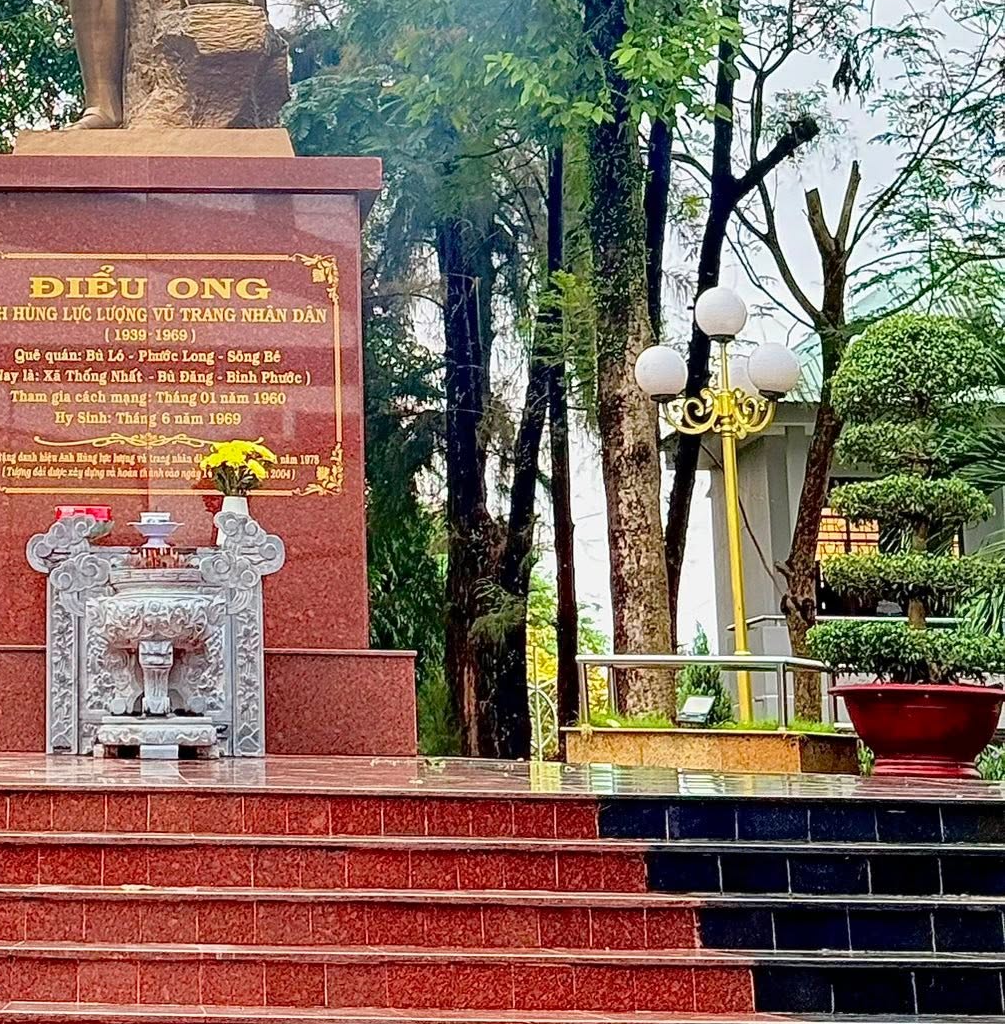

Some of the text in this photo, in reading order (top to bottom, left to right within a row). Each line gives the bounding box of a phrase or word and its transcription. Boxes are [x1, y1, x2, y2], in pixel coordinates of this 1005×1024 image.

[29, 264, 271, 299] ĐIỂU ONG
[12, 303, 58, 321] HÙNG
[62, 305, 92, 324] LỰC
[97, 305, 147, 324] LƯỢNG
[152, 304, 175, 322] VŨ
[180, 307, 236, 322] TRANG
[241, 305, 288, 323] NHÂN
[292, 305, 327, 323] DÂN
[14, 348, 41, 364] Quê
[45, 349, 82, 363] quán:
[86, 349, 104, 362] Bù
[138, 349, 179, 363] Phước
[182, 350, 215, 365] Long
[227, 350, 260, 366] Sông
[263, 350, 281, 363] Bé
[23, 369, 40, 382] là:
[43, 370, 61, 382] Xã
[66, 368, 108, 385] Thống
[111, 367, 143, 383] Nhất
[157, 370, 175, 383] Bù
[180, 371, 214, 386] Đăng
[226, 370, 257, 384] Bình
[261, 371, 302, 384] Phước
[10, 389, 286, 407] Tham gia cách mạng: Tháng 01 năm 1960
[55, 411, 241, 427] Hy Sinh: Tháng 6 năm 1969
